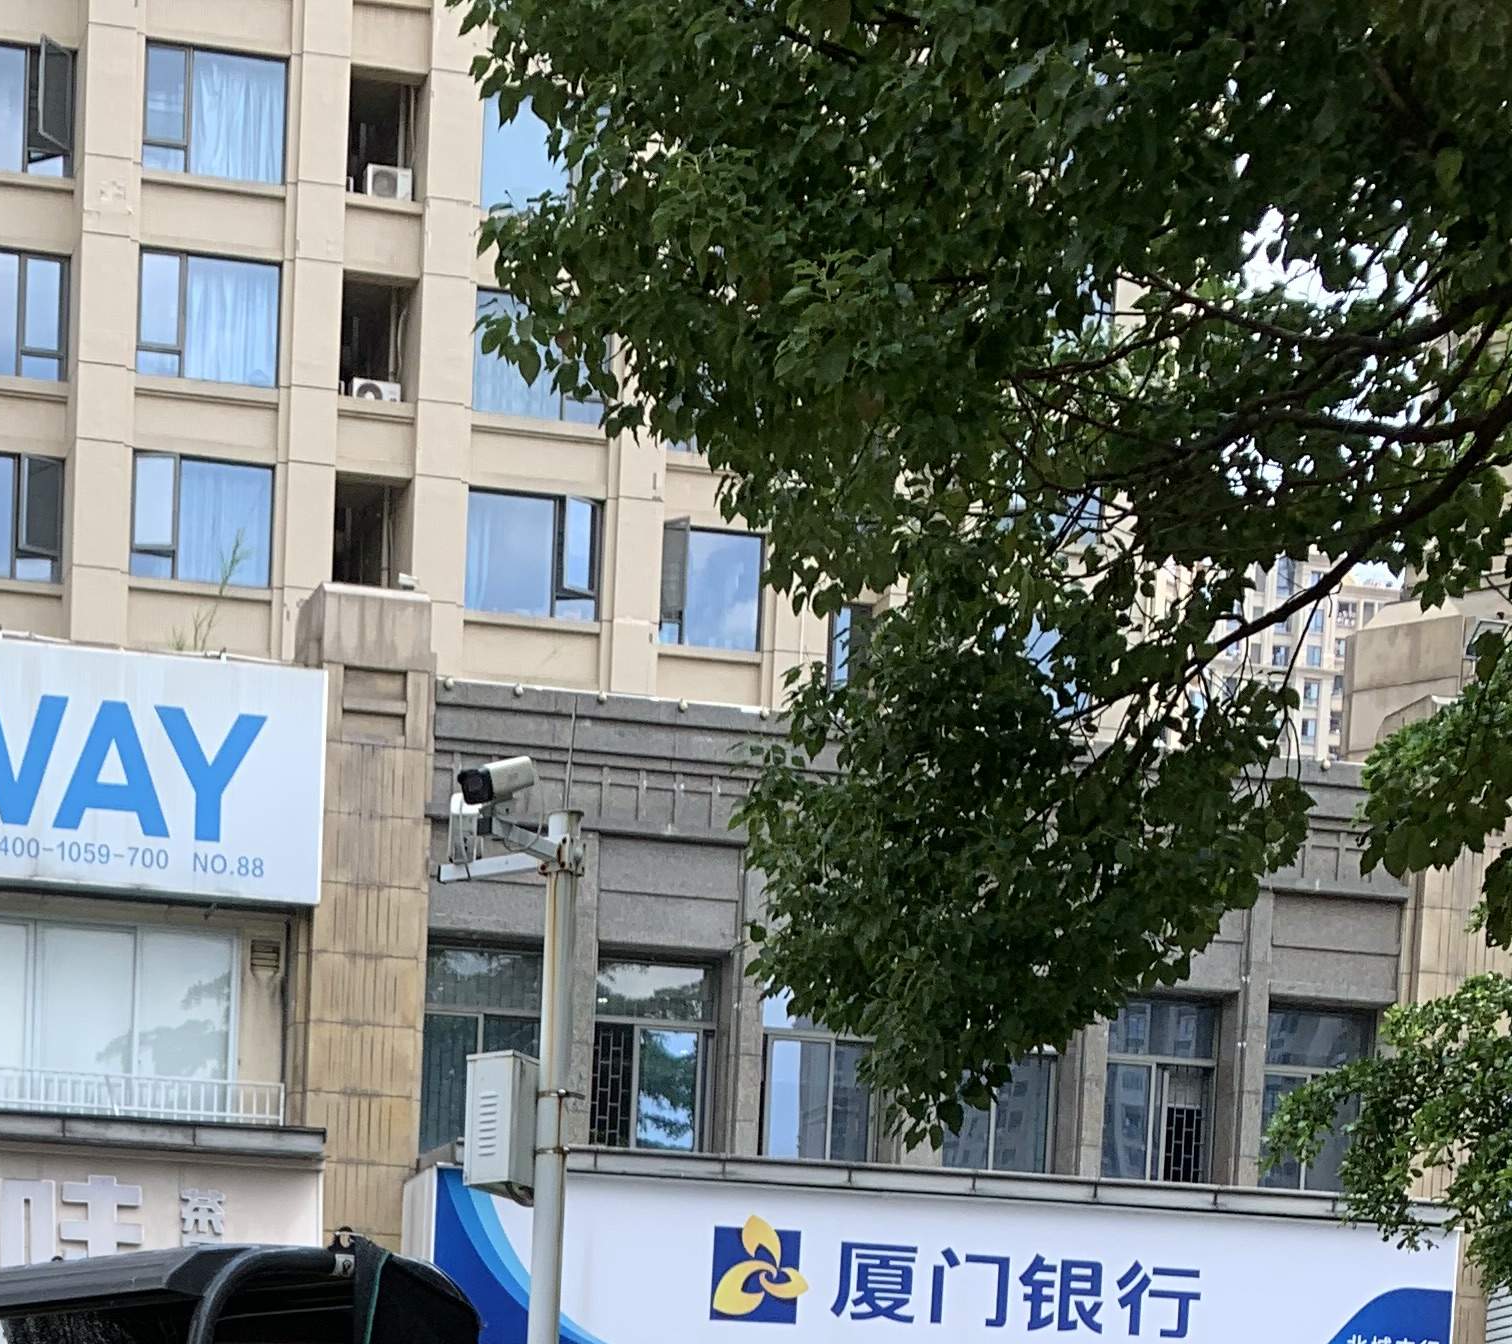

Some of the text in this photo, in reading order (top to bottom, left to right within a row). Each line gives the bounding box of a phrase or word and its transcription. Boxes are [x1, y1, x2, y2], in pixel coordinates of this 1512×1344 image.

[193, 852, 264, 878] NO.88
[831, 1241, 1202, 1339] 厦门银行
